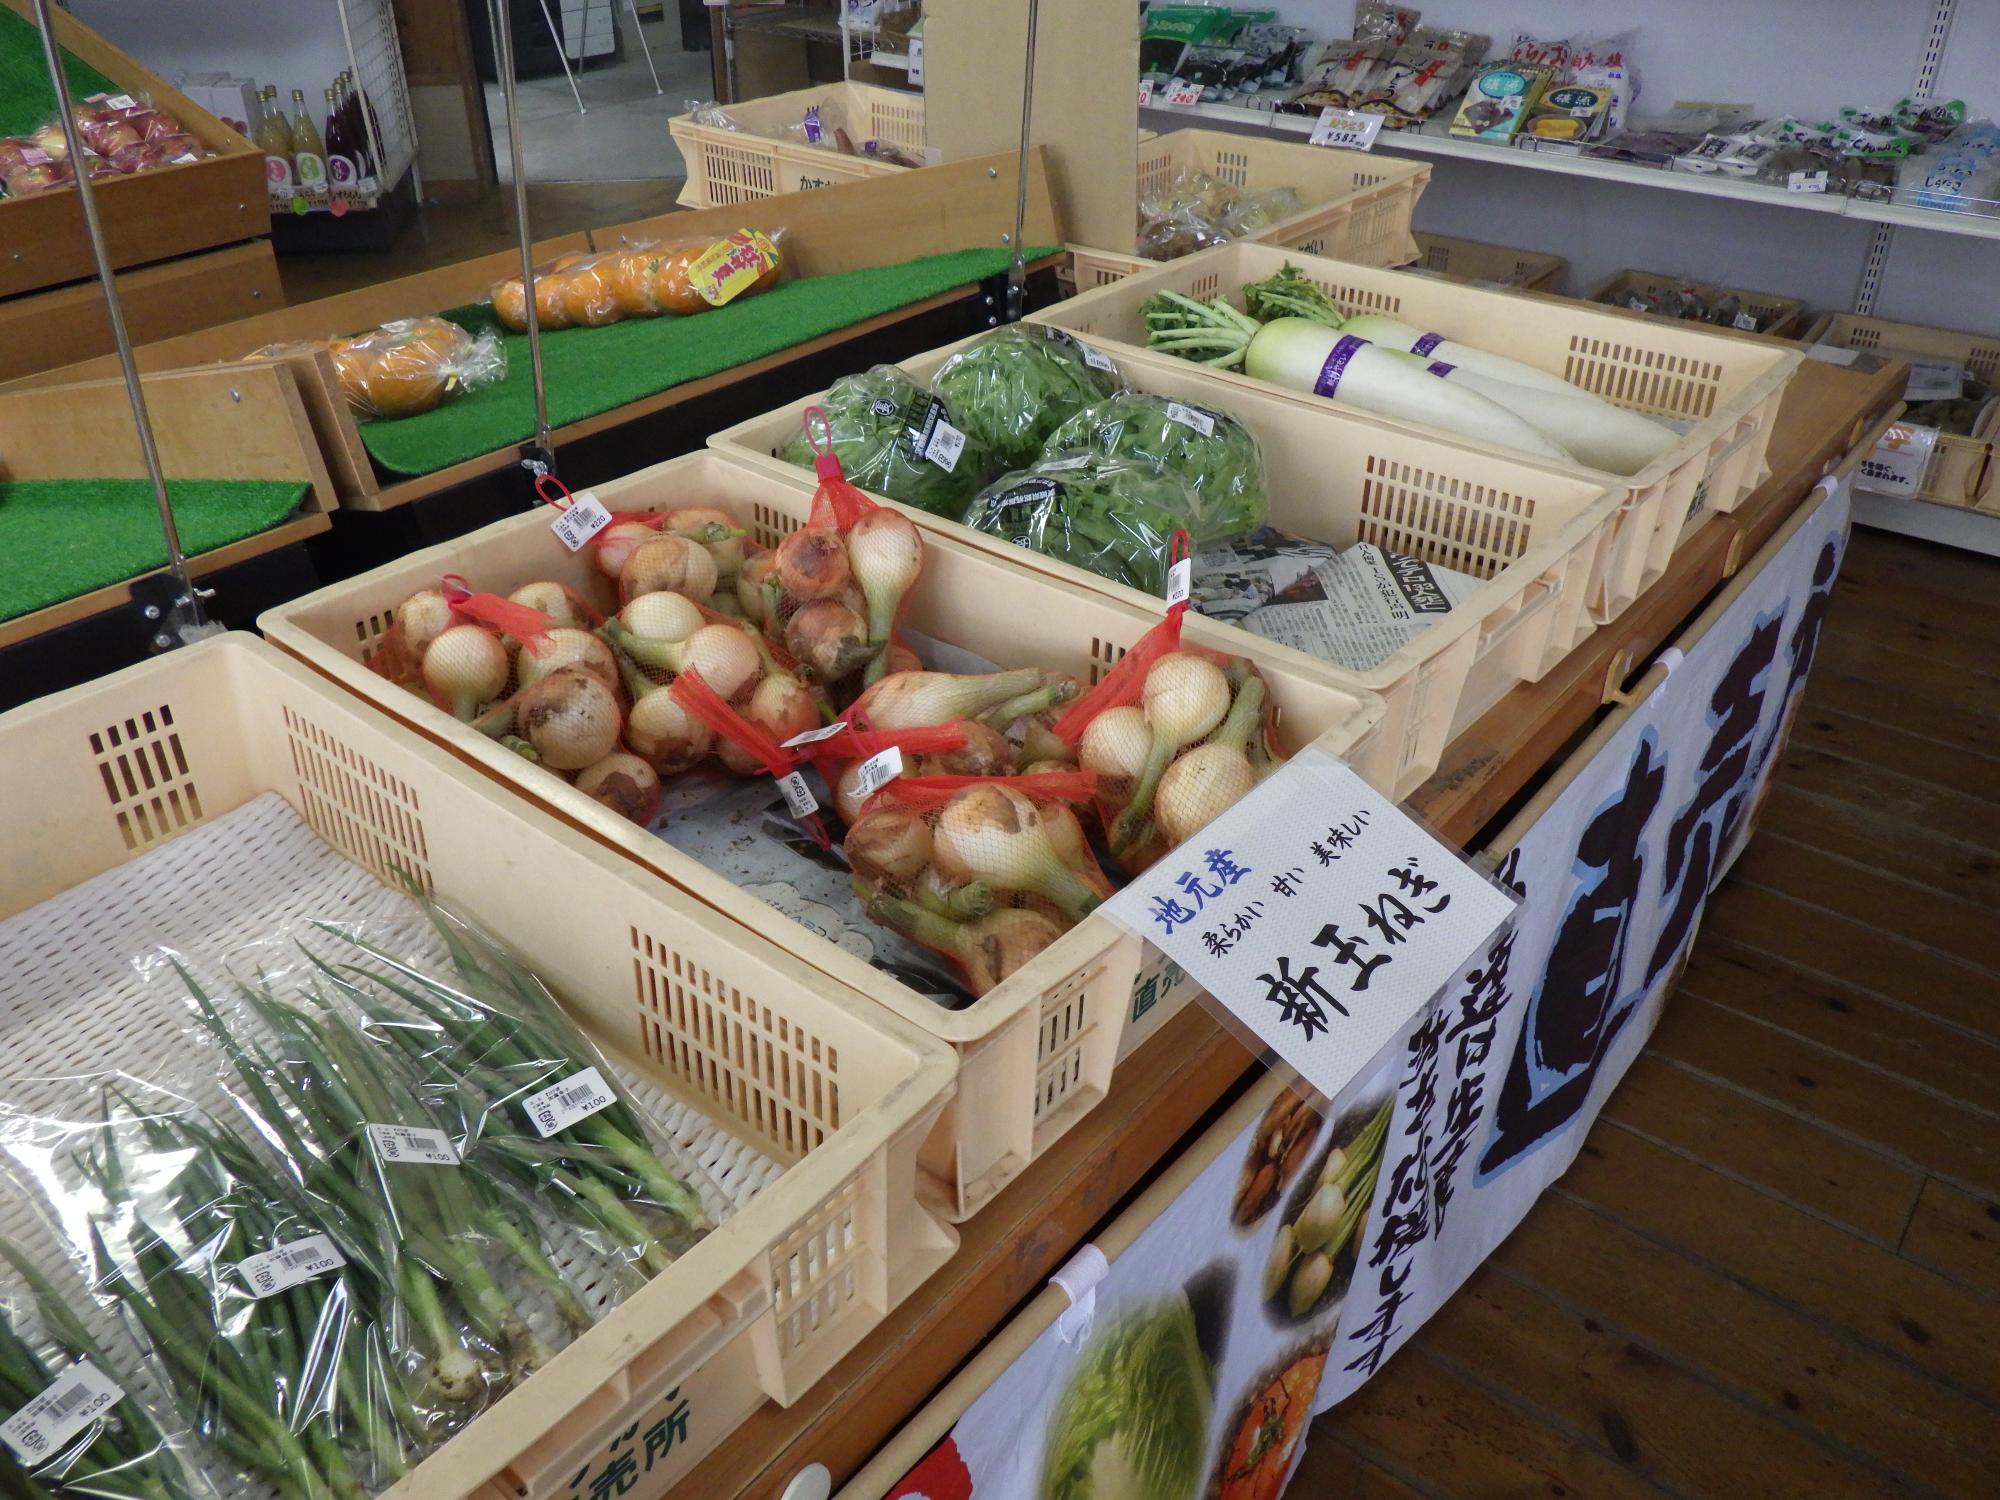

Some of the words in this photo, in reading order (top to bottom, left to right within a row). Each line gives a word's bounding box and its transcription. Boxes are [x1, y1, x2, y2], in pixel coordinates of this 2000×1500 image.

[590, 515, 606, 529] ¥220
[1151, 848, 1253, 935] 地元産
[1200, 901, 1266, 959] 柔らかい
[1271, 867, 1307, 898] 甘い
[1308, 809, 1372, 867] 美味しい
[1256, 857, 1451, 1042] 新玉ねぎ
[581, 1095, 607, 1112] ¥100
[305, 1258, 334, 1271] ¥100
